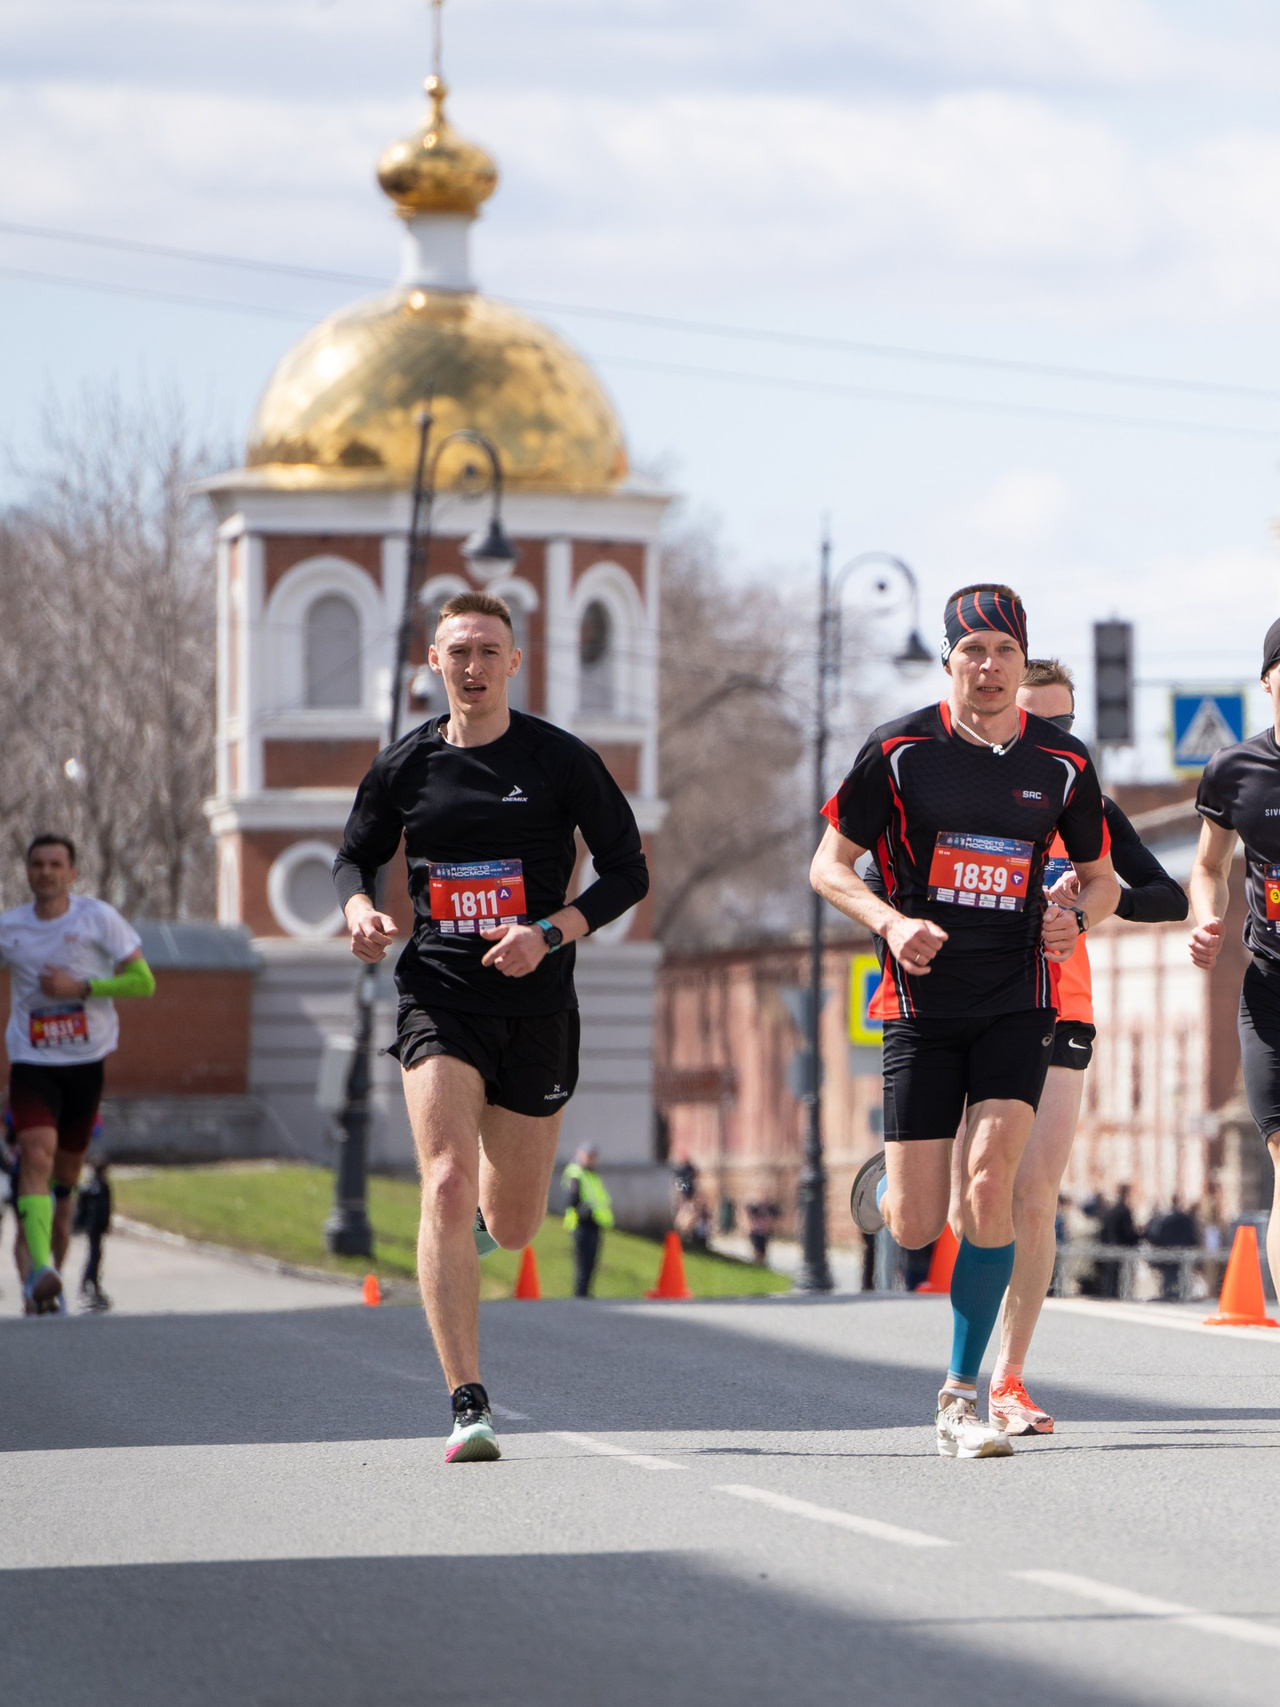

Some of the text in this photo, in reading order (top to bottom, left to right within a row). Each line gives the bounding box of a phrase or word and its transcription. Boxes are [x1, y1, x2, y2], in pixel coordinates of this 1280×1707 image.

[1022, 790, 1042, 800] SRC
[965, 842, 1004, 852] КОСМОС
[972, 838, 1005, 847] ПРОСТО
[451, 869, 491, 877] КОСМОС
[456, 864, 490, 872] ПРОСТО
[953, 861, 1008, 893] 1839
[450, 889, 499, 917] 1811
